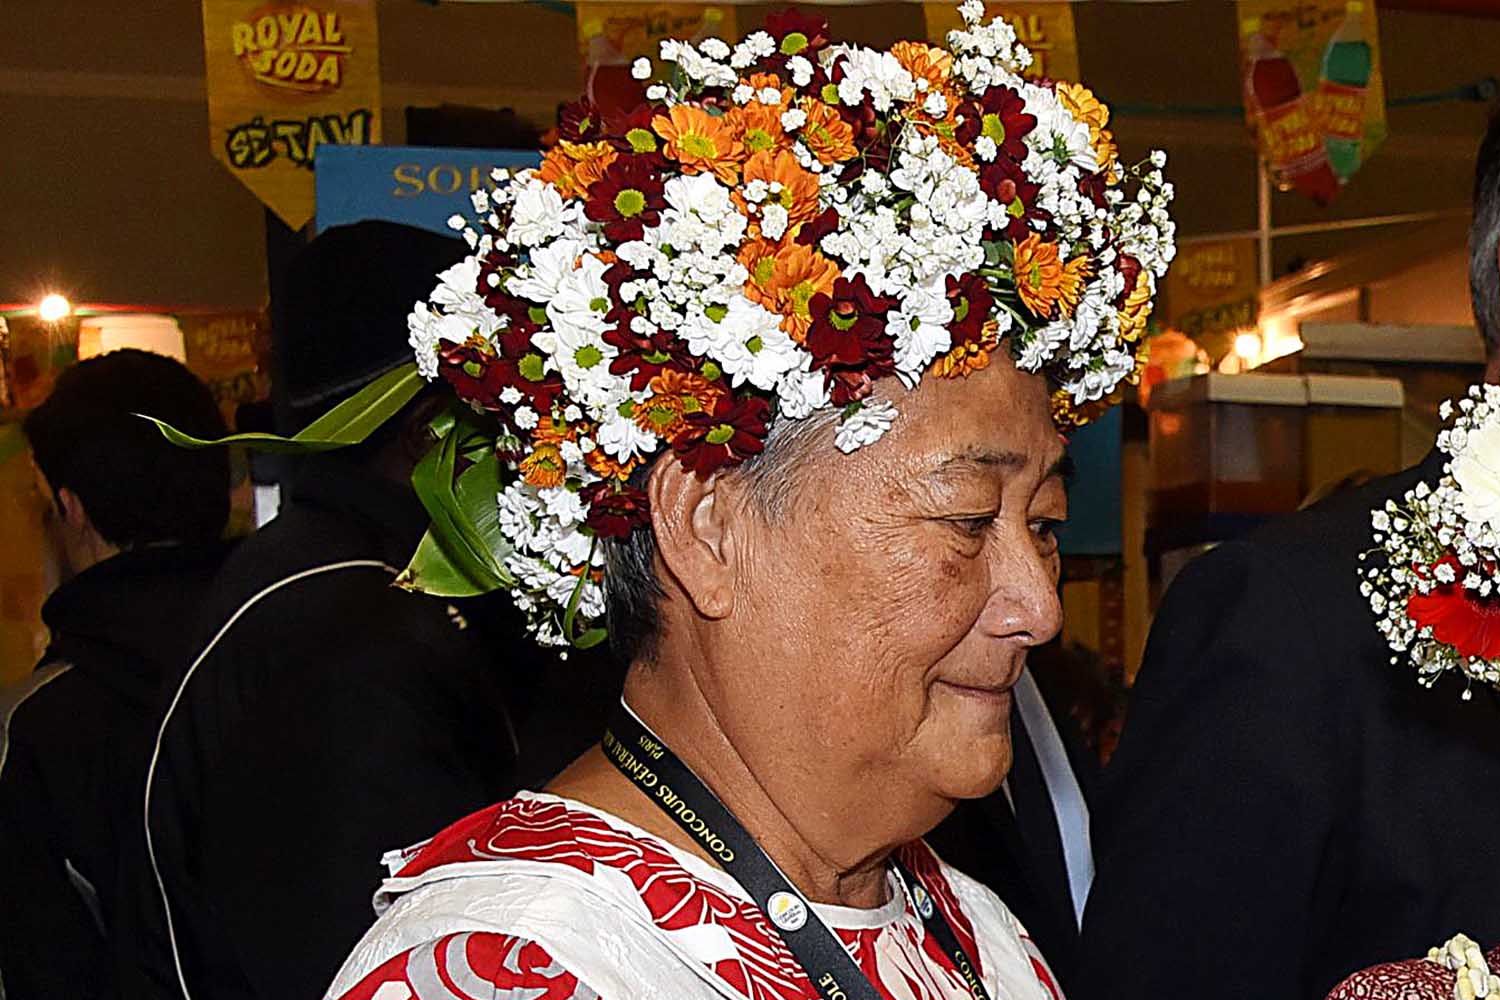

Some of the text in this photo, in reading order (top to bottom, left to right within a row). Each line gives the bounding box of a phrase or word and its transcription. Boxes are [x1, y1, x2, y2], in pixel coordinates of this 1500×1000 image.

[232, 10, 343, 56] ROYAL
[253, 50, 341, 85] SODA
[638, 735, 665, 760] PARIS
[655, 784, 736, 863] CONCOURS
